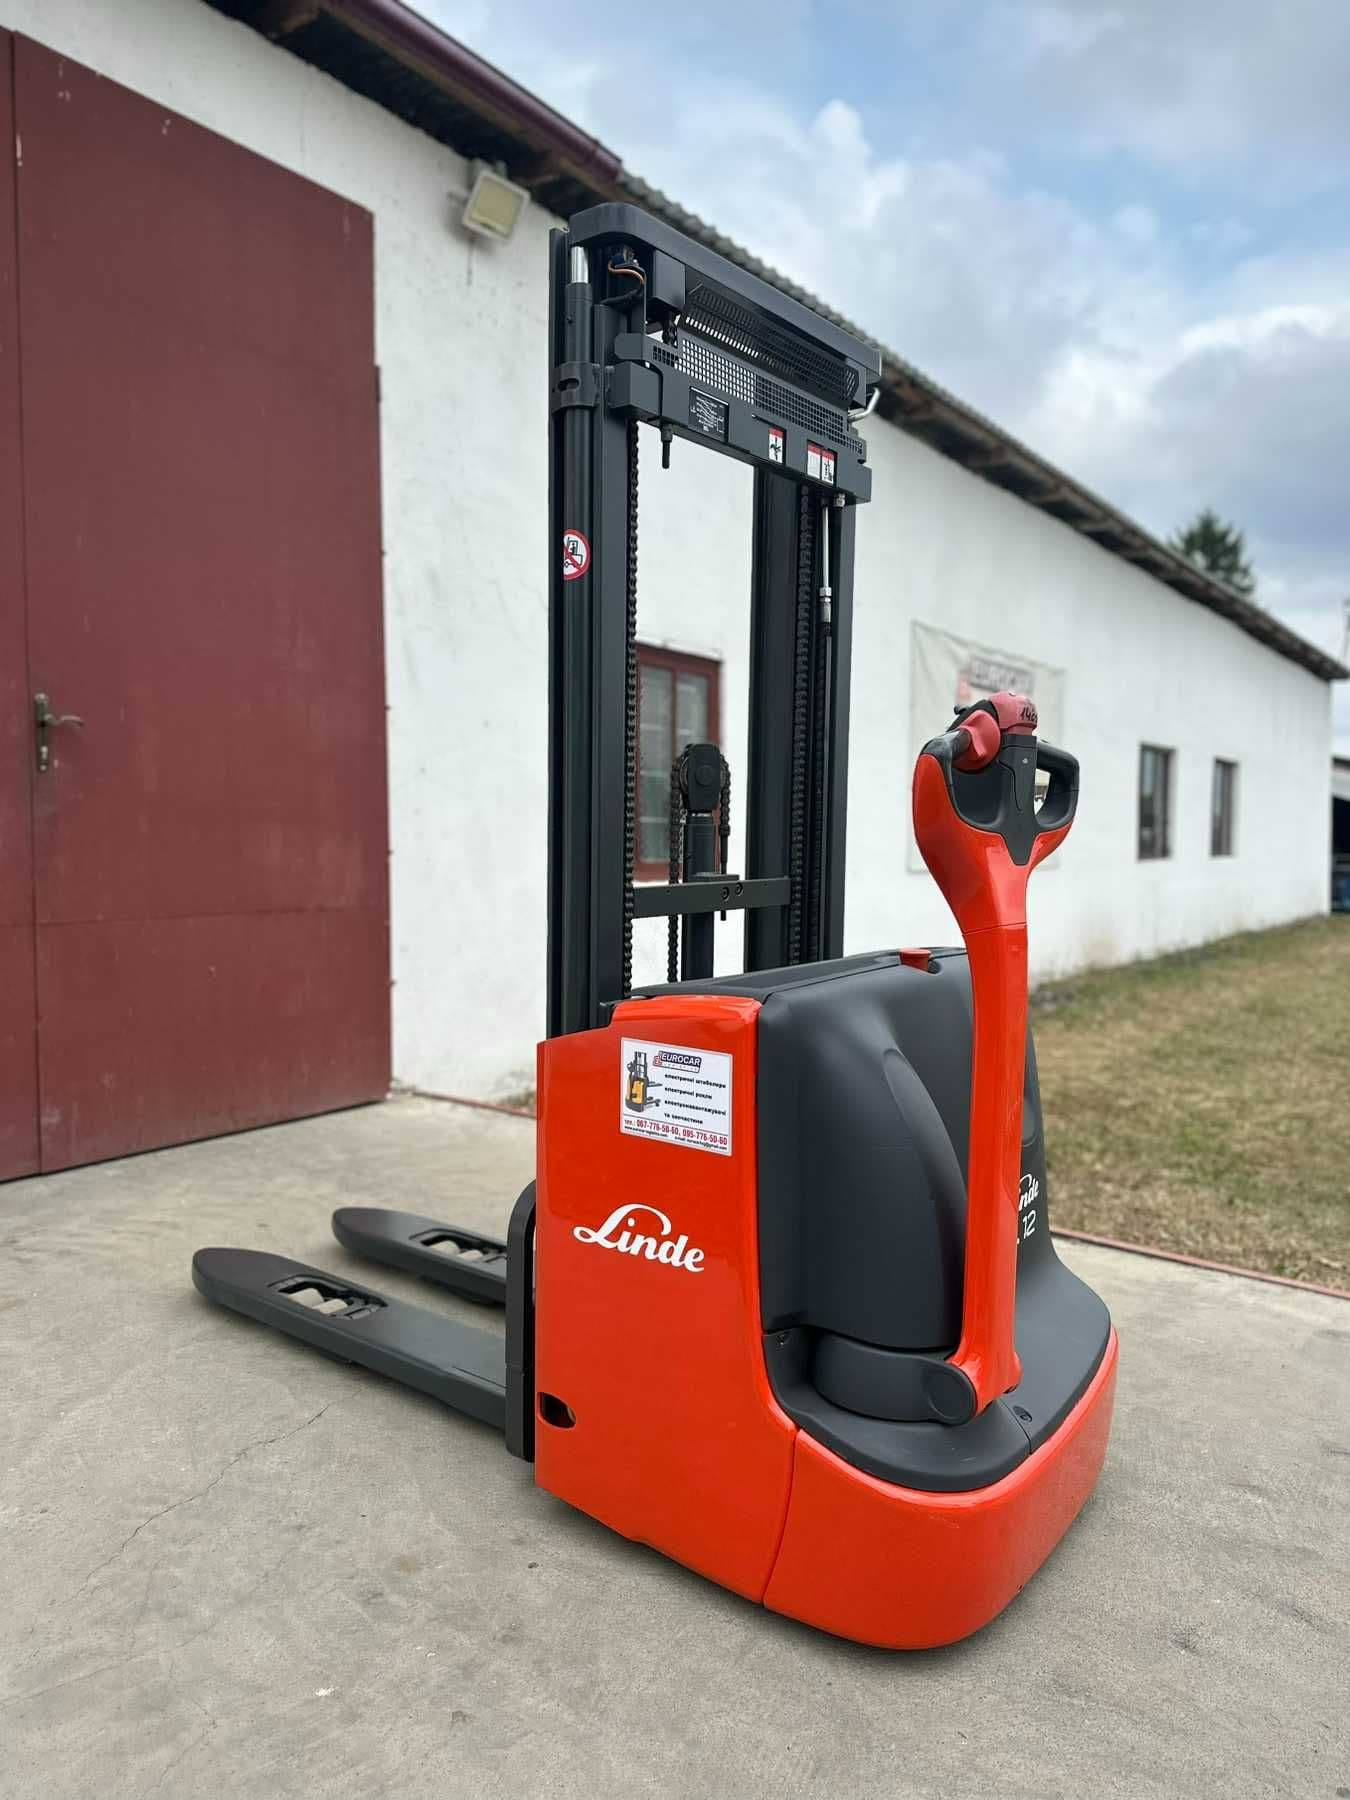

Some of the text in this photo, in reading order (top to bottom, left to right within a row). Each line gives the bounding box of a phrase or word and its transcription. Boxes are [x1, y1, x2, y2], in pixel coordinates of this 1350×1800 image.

[661, 1052, 701, 1067] EUROCAR
[573, 1203, 705, 1272] Linde
[1022, 1209, 1036, 1239] 12
